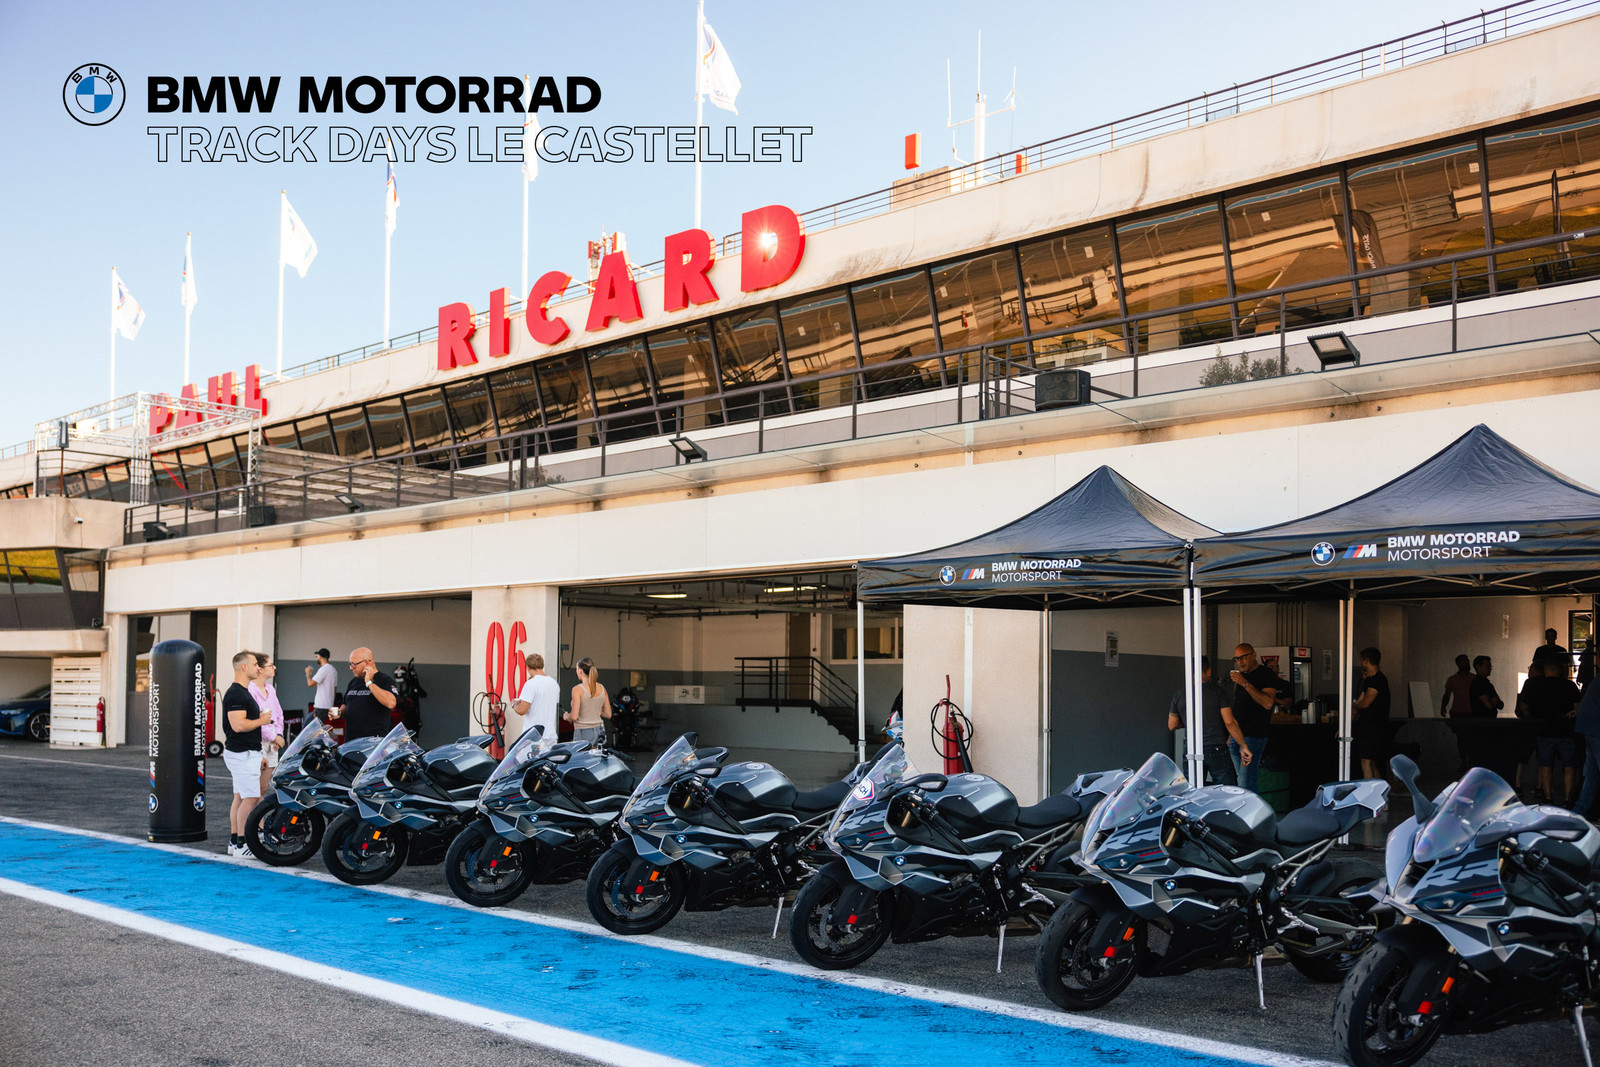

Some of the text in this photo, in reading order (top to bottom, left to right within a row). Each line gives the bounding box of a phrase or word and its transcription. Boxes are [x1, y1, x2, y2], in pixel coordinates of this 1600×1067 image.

[437, 205, 806, 371] RICARD
[1387, 531, 1520, 548] BMW MOTORRAD
[1387, 546, 1492, 561] MOTORSPORT
[991, 559, 1082, 572] BMW MOTORRAD
[991, 571, 1062, 583] MOTORSPORT
[485, 621, 527, 705] 06
[152, 682, 160, 757] MOTORSPORT
[194, 662, 203, 756] BMW MOTORRAD
